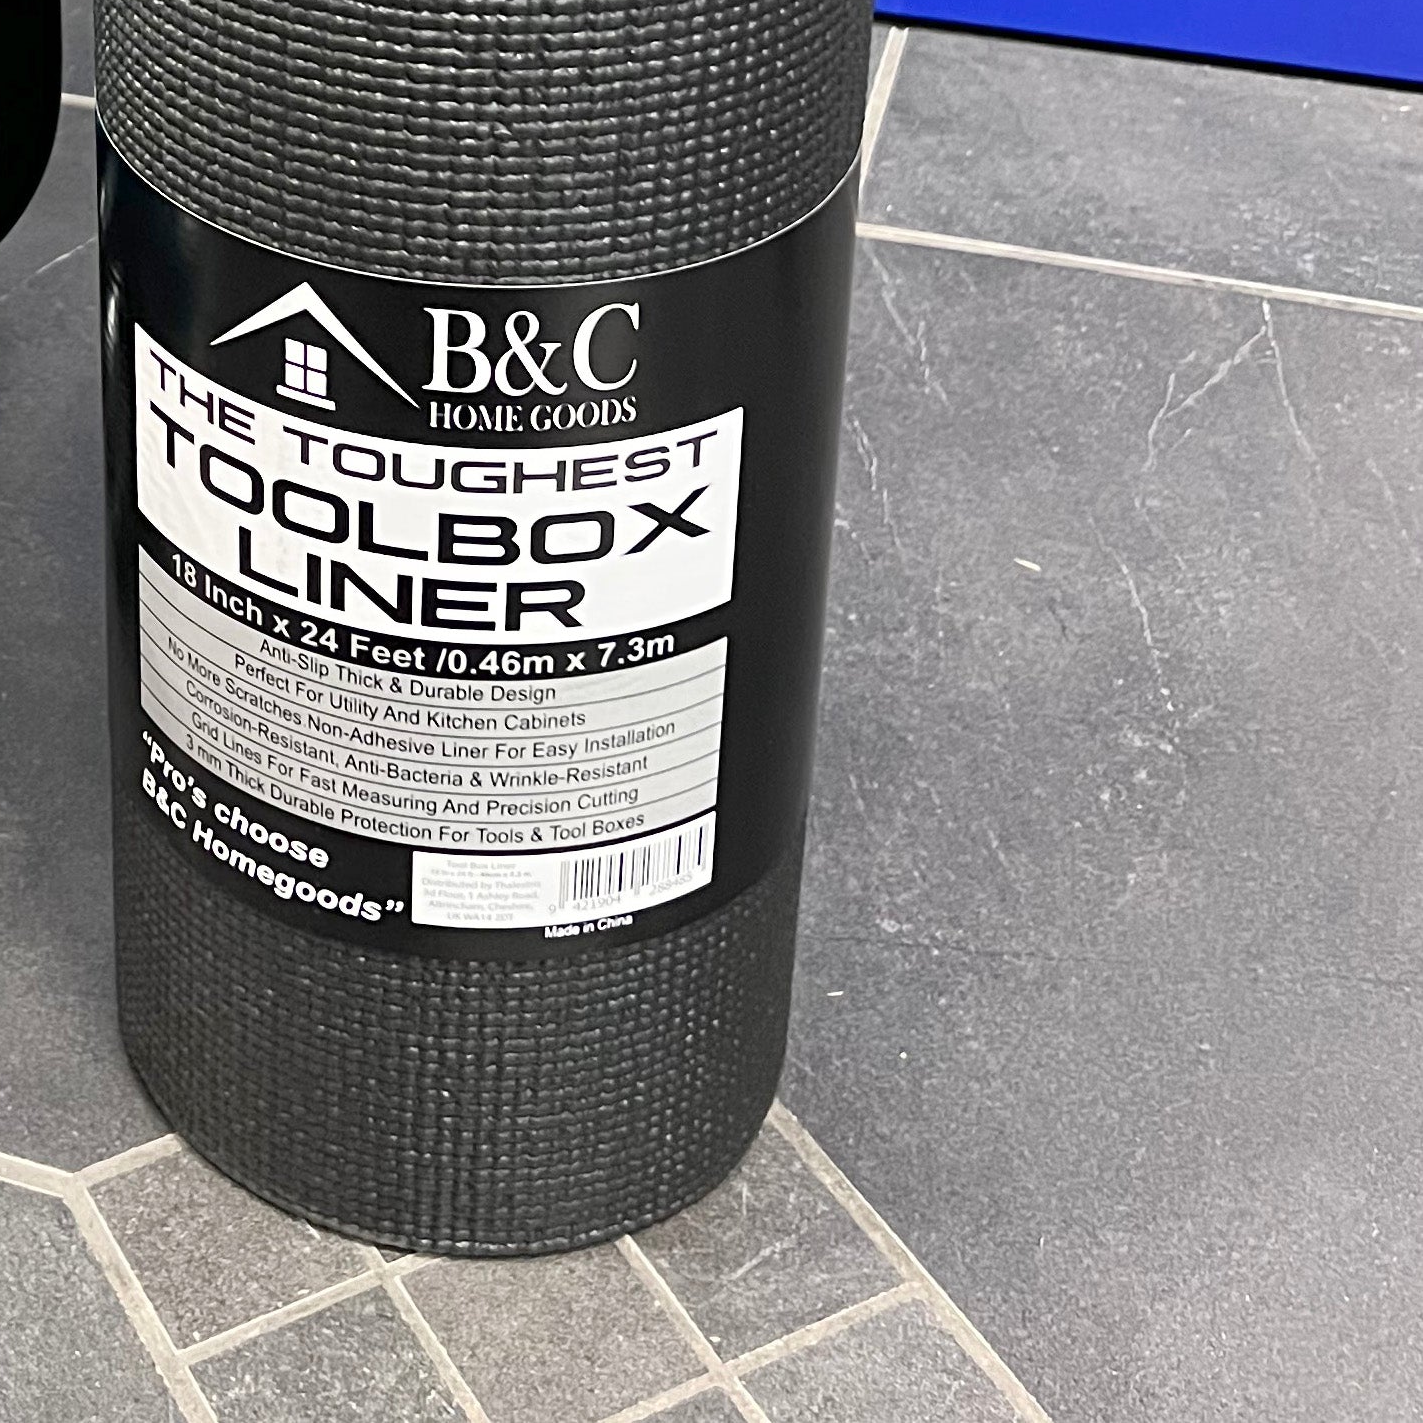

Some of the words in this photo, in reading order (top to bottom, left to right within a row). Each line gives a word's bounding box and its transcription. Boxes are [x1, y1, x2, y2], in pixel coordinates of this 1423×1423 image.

[422, 302, 639, 397] B&C
[150, 348, 256, 445] THE
[283, 425, 718, 495] TOUGHEST
[430, 401, 523, 432] HOME
[530, 396, 637, 432] GOODS
[150, 400, 712, 566] TOOLBOX
[172, 554, 197, 588] 18
[205, 575, 263, 626] Inch
[272, 614, 290, 638] x
[300, 621, 339, 653] 24
[350, 633, 426, 671] Feet
[436, 648, 554, 676] /0.46m
[565, 651, 586, 672] x
[598, 634, 675, 667] 7.3m
[239, 526, 585, 632] LINER
[168, 636, 184, 661] No
[188, 652, 221, 687] More
[441, 742, 489, 759] Liner
[495, 743, 526, 759] For
[532, 741, 578, 760] Easy
[584, 721, 675, 754] Installation
[234, 654, 290, 693] Perfect
[295, 681, 325, 703] For
[330, 692, 379, 722] Utility
[383, 705, 420, 726] And
[427, 710, 498, 730] Kitchen
[504, 712, 586, 731] Cabinets
[260, 638, 329, 678] Anti-Slip
[335, 664, 384, 691] Thick
[389, 676, 403, 694] &
[410, 679, 484, 702] Durable
[491, 685, 556, 705] Design
[186, 679, 340, 769] Corrosion-Resistant,
[344, 754, 463, 788] Anti-Bacteria
[470, 771, 483, 788] &
[489, 755, 648, 788] Wrinkle-Resistant
[192, 711, 219, 742] Grid
[223, 731, 262, 765] Lines
[267, 754, 294, 778] For
[299, 767, 337, 794] Fast
[342, 780, 437, 817] Measuring
[443, 798, 480, 816] And
[486, 797, 571, 816] Precision
[577, 787, 639, 811] Cutting
[141, 766, 188, 830] B&C
[185, 733, 195, 751] 3
[197, 744, 223, 771] mm
[225, 759, 265, 795] Thick
[270, 782, 335, 821] Durable
[341, 808, 433, 841] Protection
[438, 825, 470, 842] For
[476, 827, 524, 844] Tools
[530, 826, 543, 843] &
[549, 822, 587, 842] Tool
[592, 813, 645, 837] Boxes
[213, 802, 330, 869] choose
[544, 924, 580, 939] Made
[582, 920, 595, 934] in
[596, 914, 634, 931] China
